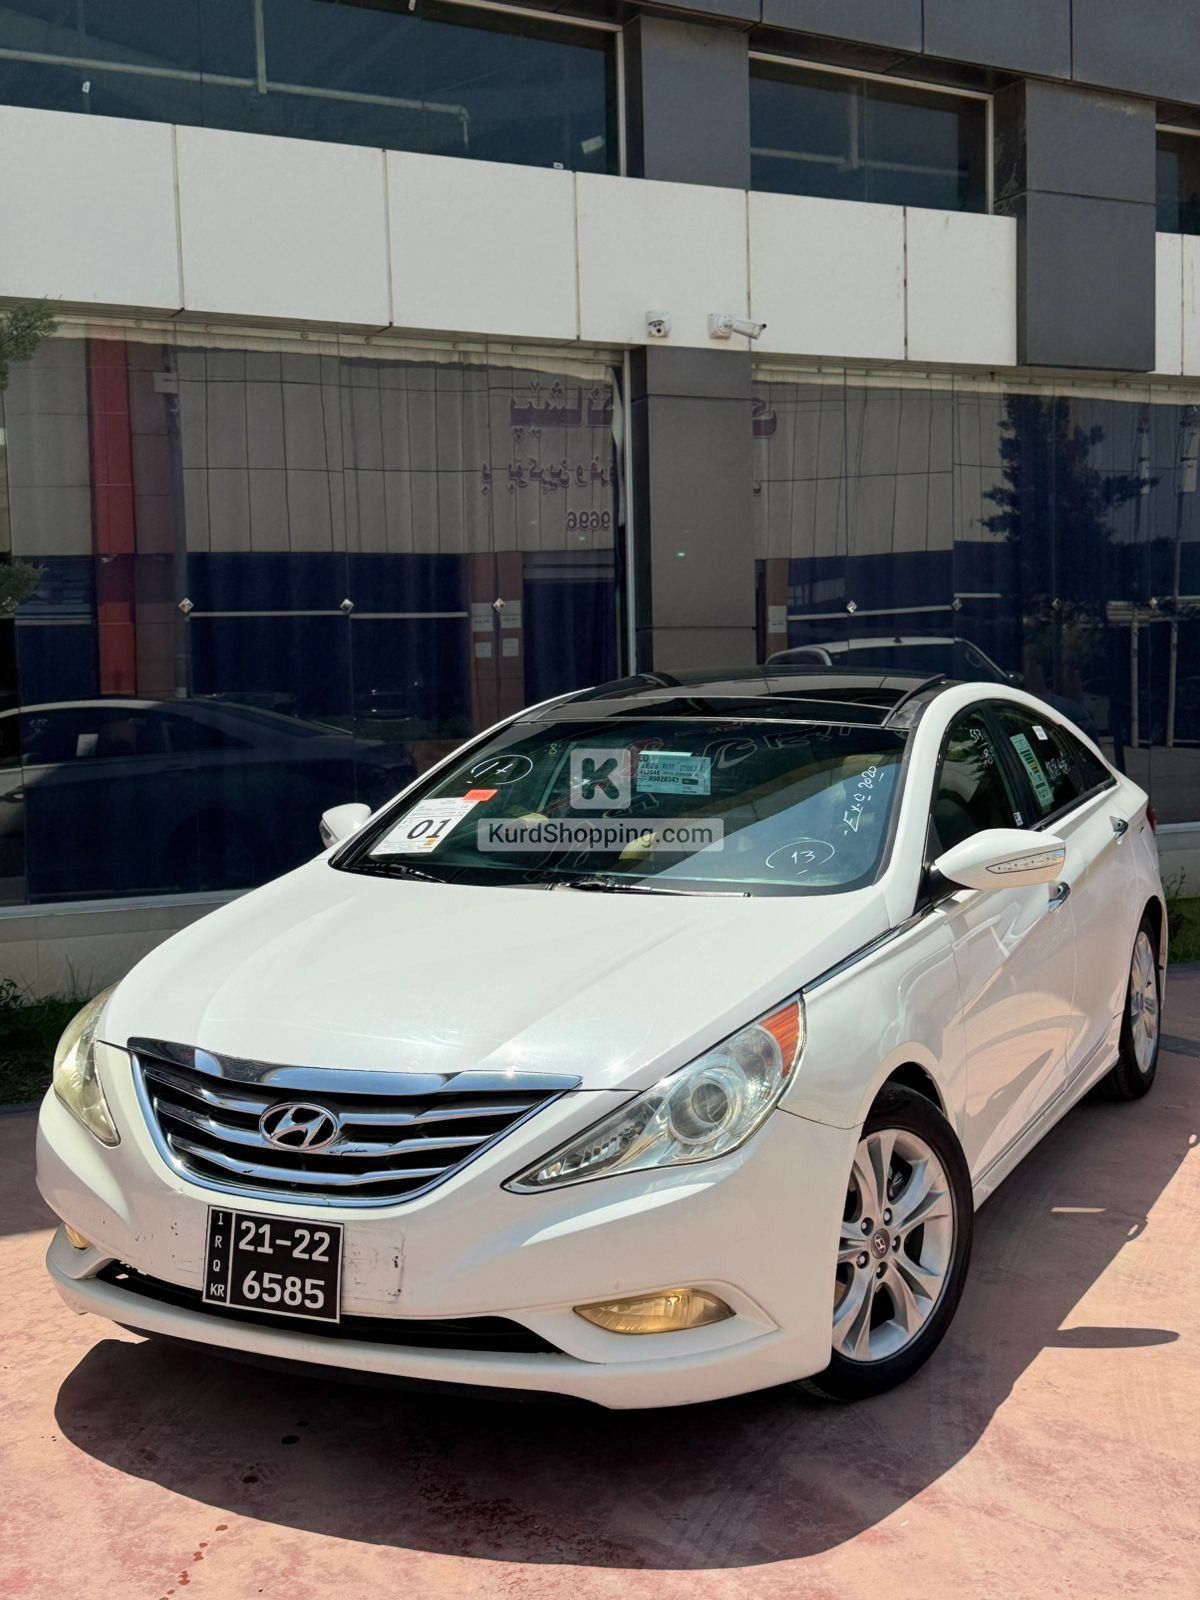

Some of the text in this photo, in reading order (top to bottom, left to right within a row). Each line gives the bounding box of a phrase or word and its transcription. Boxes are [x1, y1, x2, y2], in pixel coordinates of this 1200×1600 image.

[407, 818, 451, 840] 01
[791, 850, 816, 864] 13
[238, 1220, 331, 1262] 21-22
[210, 1283, 225, 1297] KR
[242, 1270, 326, 1310] 6585
